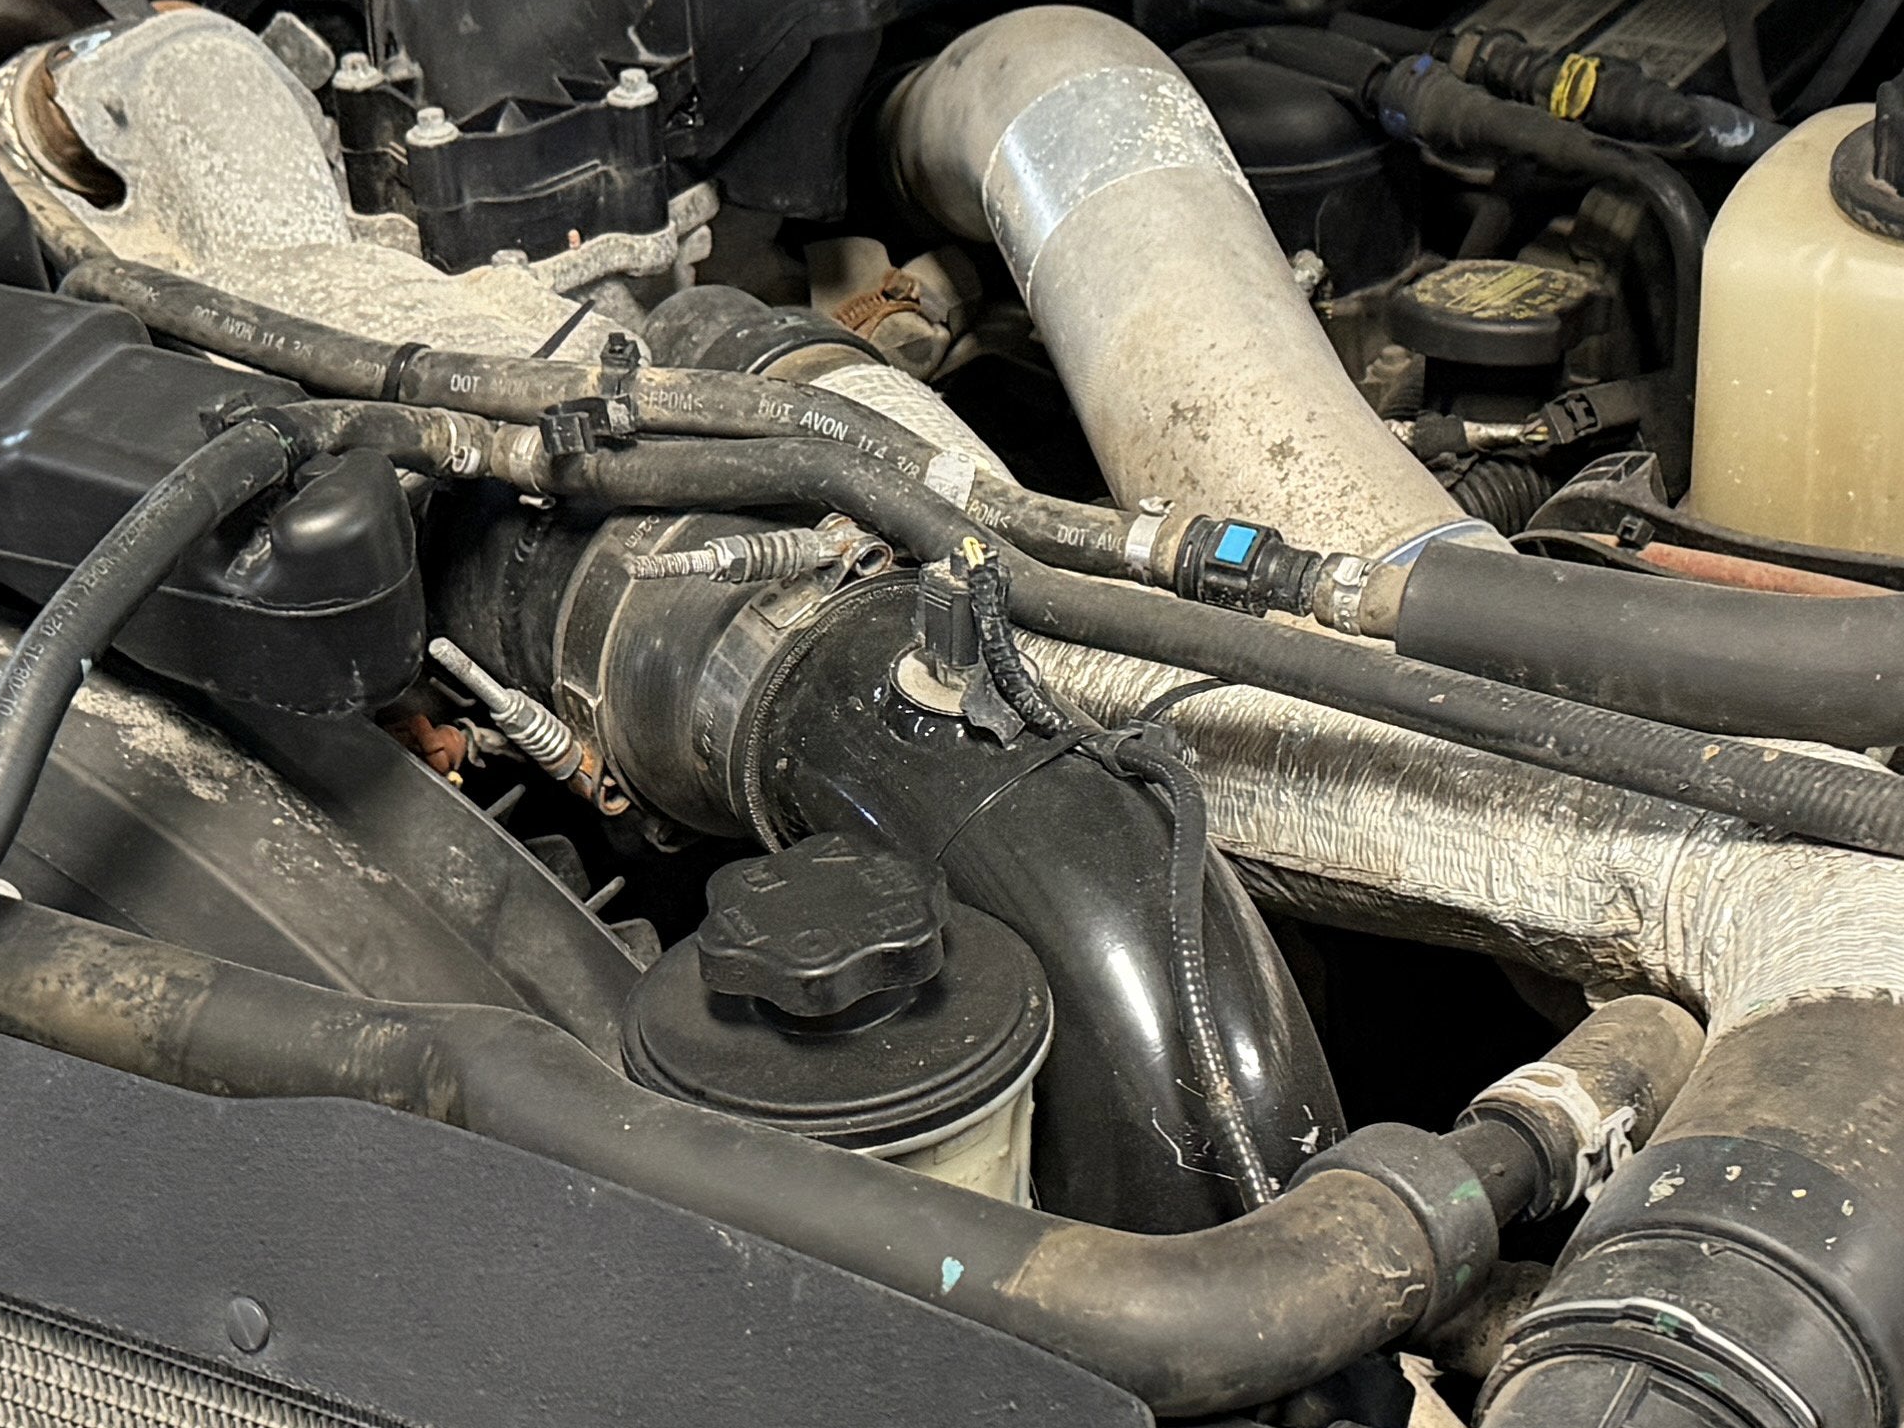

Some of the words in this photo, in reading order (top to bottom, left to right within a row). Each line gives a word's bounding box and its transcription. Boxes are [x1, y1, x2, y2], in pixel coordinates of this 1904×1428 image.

[758, 397, 795, 421] DOT
[799, 410, 849, 442] AVON
[1056, 523, 1087, 548] DOT
[1095, 534, 1126, 553] AVO
